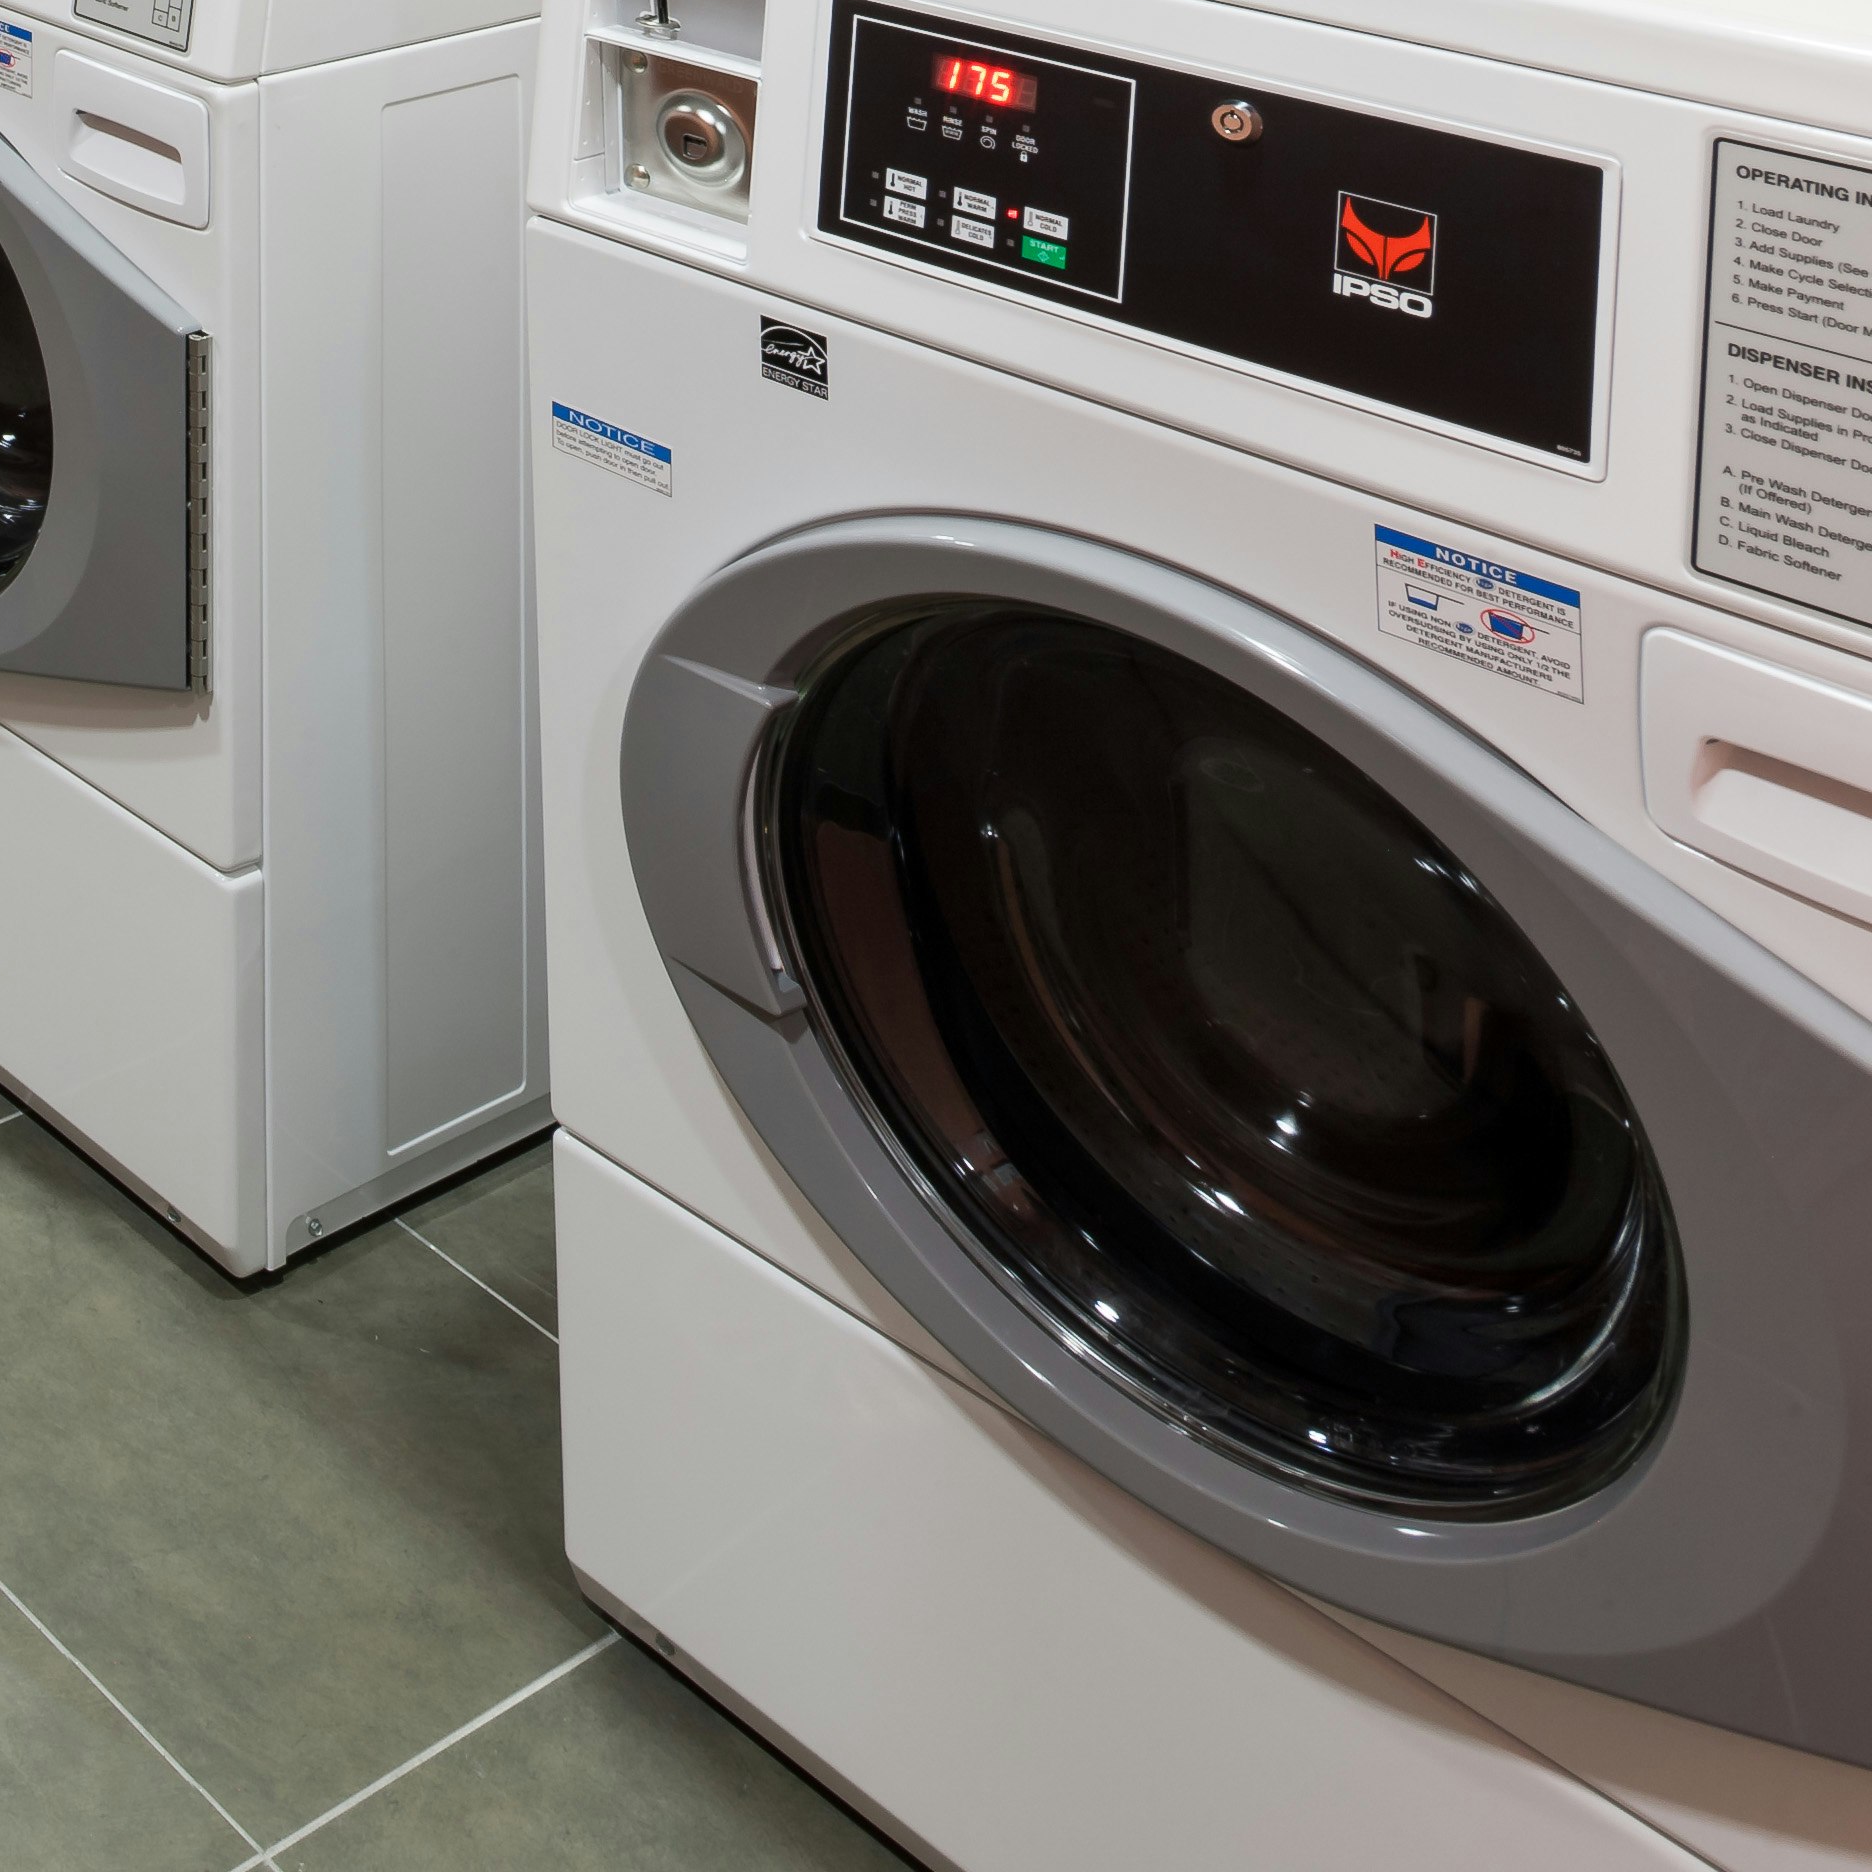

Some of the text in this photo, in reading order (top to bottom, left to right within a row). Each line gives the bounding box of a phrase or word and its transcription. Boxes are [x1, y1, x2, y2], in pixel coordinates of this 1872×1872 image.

[949, 61, 1010, 102] 175
[897, 175, 922, 188] NORMAL
[1736, 165, 1849, 202] OPERATING
[964, 194, 990, 207] NORMAL
[966, 203, 987, 213] WARM
[1752, 203, 1783, 219] Load
[1788, 211, 1839, 234] Laundry
[1035, 214, 1062, 227] NORMAL
[1040, 222, 1057, 233] COLD
[1751, 222, 1787, 239] Close
[1791, 231, 1823, 247] Door
[1029, 239, 1059, 253] START
[1749, 241, 1774, 255] Add
[1778, 248, 1834, 270] Supplies
[1838, 262, 1869, 278] (See
[1749, 259, 1784, 276] Make
[1788, 269, 1824, 286] Cycle
[1333, 272, 1432, 319] IPSO
[1748, 278, 1783, 295] Make
[1787, 287, 1844, 310] Payment
[1747, 296, 1784, 315] Press
[1788, 307, 1818, 324] Start
[1822, 316, 1859, 333] (Door
[763, 366, 828, 398] ENERGY STAR
[1728, 343, 1840, 385] DISPENSER
[1743, 378, 1778, 396] Open
[1782, 388, 1848, 414] Dispenser
[569, 410, 656, 456] NOTICE
[1741, 398, 1773, 416] Load
[1777, 408, 1833, 432] Supplies
[1837, 424, 1848, 437] in
[1741, 413, 1818, 442] as Indicated
[556, 420, 664, 470] DOOR LOCK LIGHT must go out
[556, 429, 576, 442] before
[622, 457, 639, 469] open
[586, 450, 601, 462] push
[603, 457, 618, 468] door
[1740, 428, 1777, 446] Close
[1781, 439, 1846, 466] Dispenser
[1722, 465, 1736, 477] A.
[1741, 470, 1764, 485] Pre
[1768, 478, 1807, 498] Wash
[1738, 483, 1812, 515] (If Offered)
[1720, 496, 1733, 509] B.
[1738, 502, 1771, 520] Main
[1775, 513, 1814, 533] Wash
[1719, 516, 1829, 558] C. Liquid Bleach
[1435, 547, 1517, 584] NOTICE
[1718, 534, 1842, 581] D. Fabric Softener
[1383, 557, 1453, 587] RECOMMENDED
[1455, 582, 1474, 594] FOR
[1476, 589, 1499, 603] BEST
[1502, 598, 1574, 628] PERFORMANCE
[1389, 548, 1415, 564] HIGH
[1417, 558, 1471, 584] EFFICIENCY
[1498, 587, 1554, 612] DETERGENT
[1556, 606, 1566, 616] IS
[1388, 600, 1397, 608] IF
[1399, 605, 1429, 619] USING
[1430, 614, 1452, 628] NON
[1541, 654, 1570, 670] AVOID
[1388, 610, 1456, 639] OVERSUDSING
[1459, 634, 1472, 644] BY
[1474, 639, 1505, 655] USING
[1507, 650, 1533, 665] ONLY
[1551, 667, 1570, 679] THE
[1406, 624, 1463, 650] DETERGENT
[1466, 646, 1553, 682] MANUFACTURERS
[1418, 637, 1494, 670] RECOMMENDED
